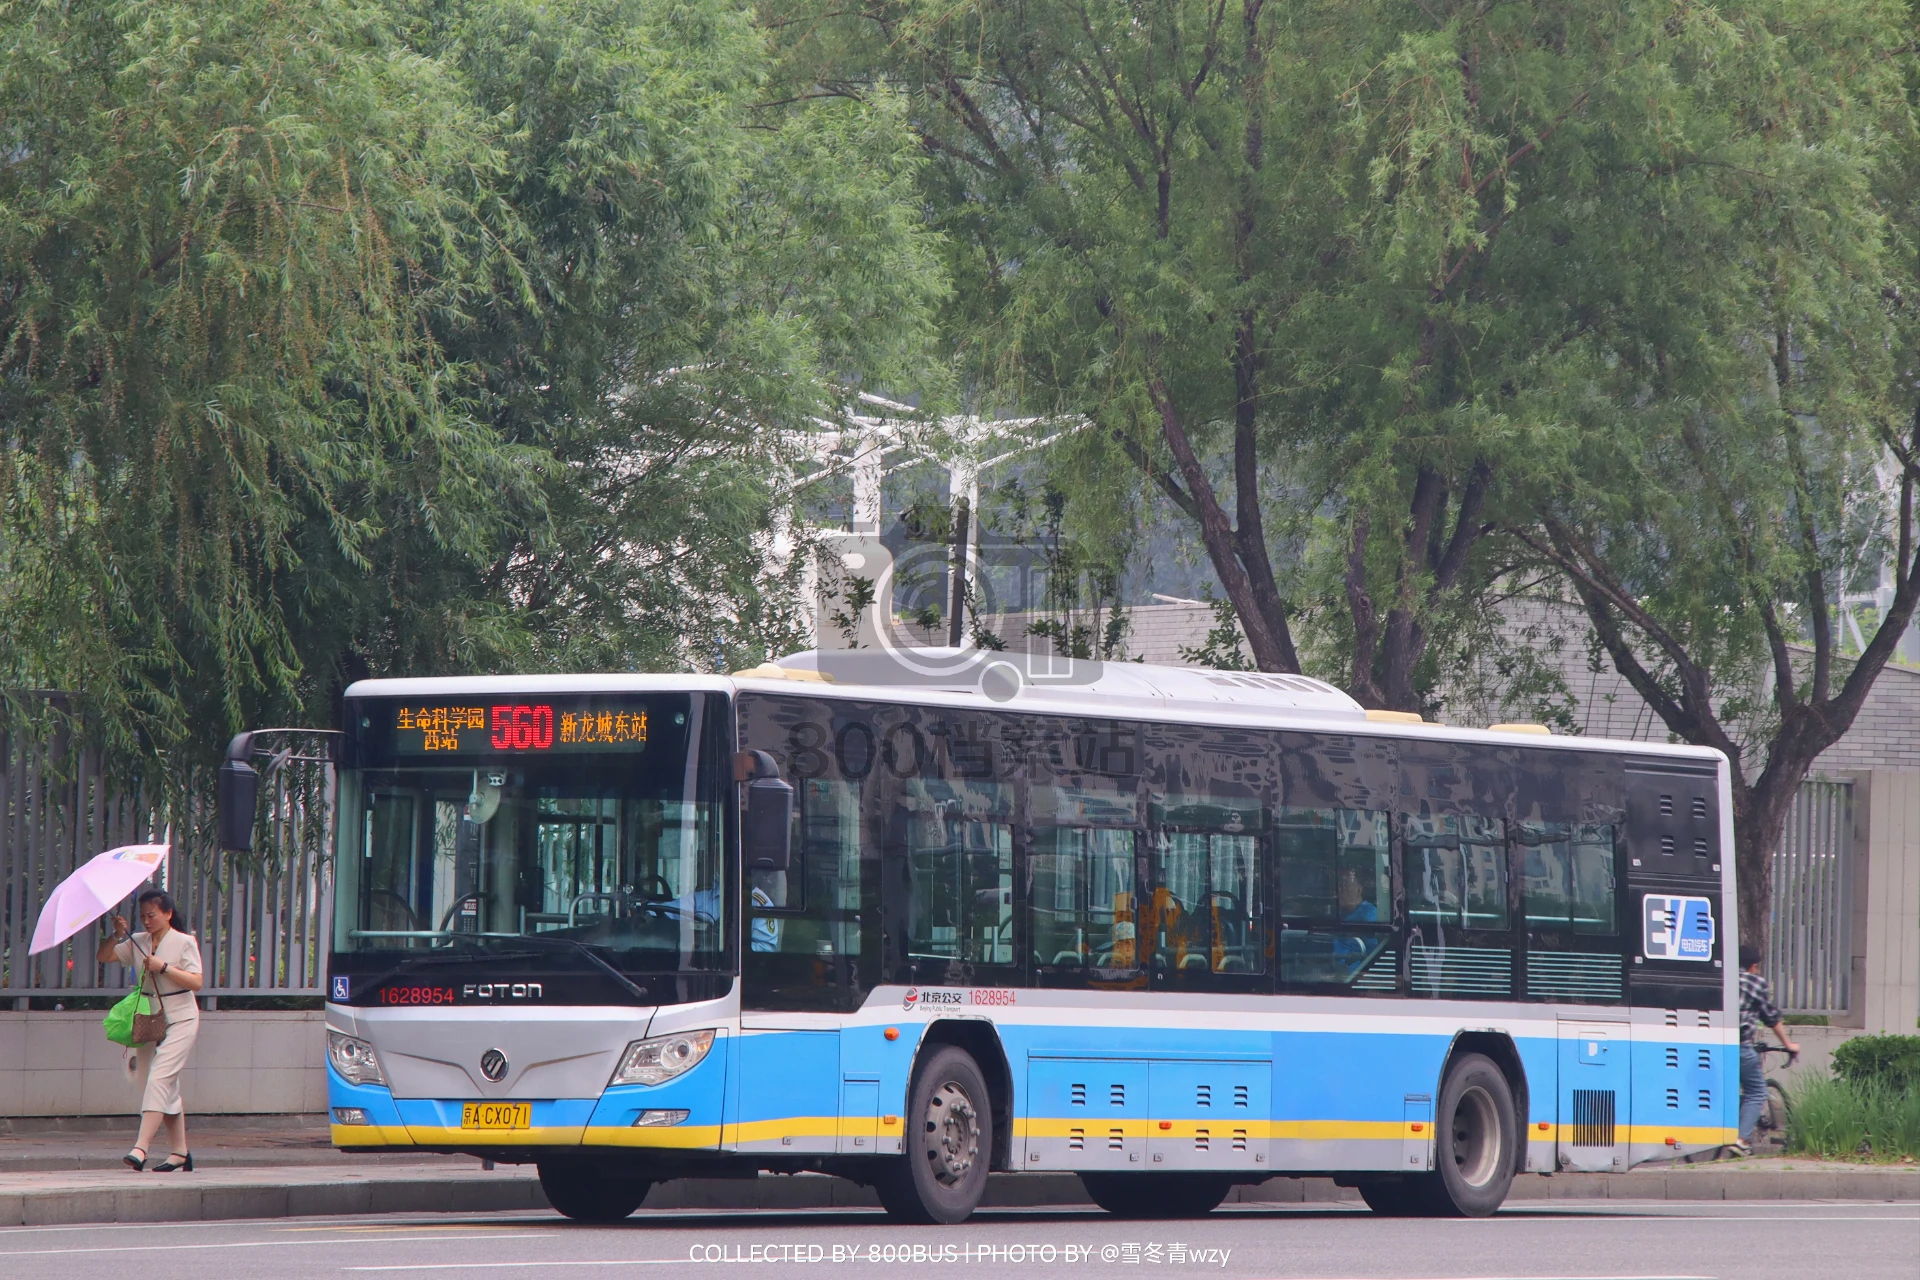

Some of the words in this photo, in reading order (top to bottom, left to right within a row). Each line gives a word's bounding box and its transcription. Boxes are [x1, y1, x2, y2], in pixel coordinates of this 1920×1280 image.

[397, 707, 485, 730] 生命科学园
[491, 705, 553, 749] 560
[559, 710, 648, 744] 新龙城东站
[424, 728, 459, 751] 西站
[1681, 938, 1708, 953] 电动汽车
[379, 987, 455, 1004] 1628954
[462, 983, 542, 998] FOTON
[921, 991, 962, 1004] 北京公交
[968, 989, 1016, 1006] 1628954
